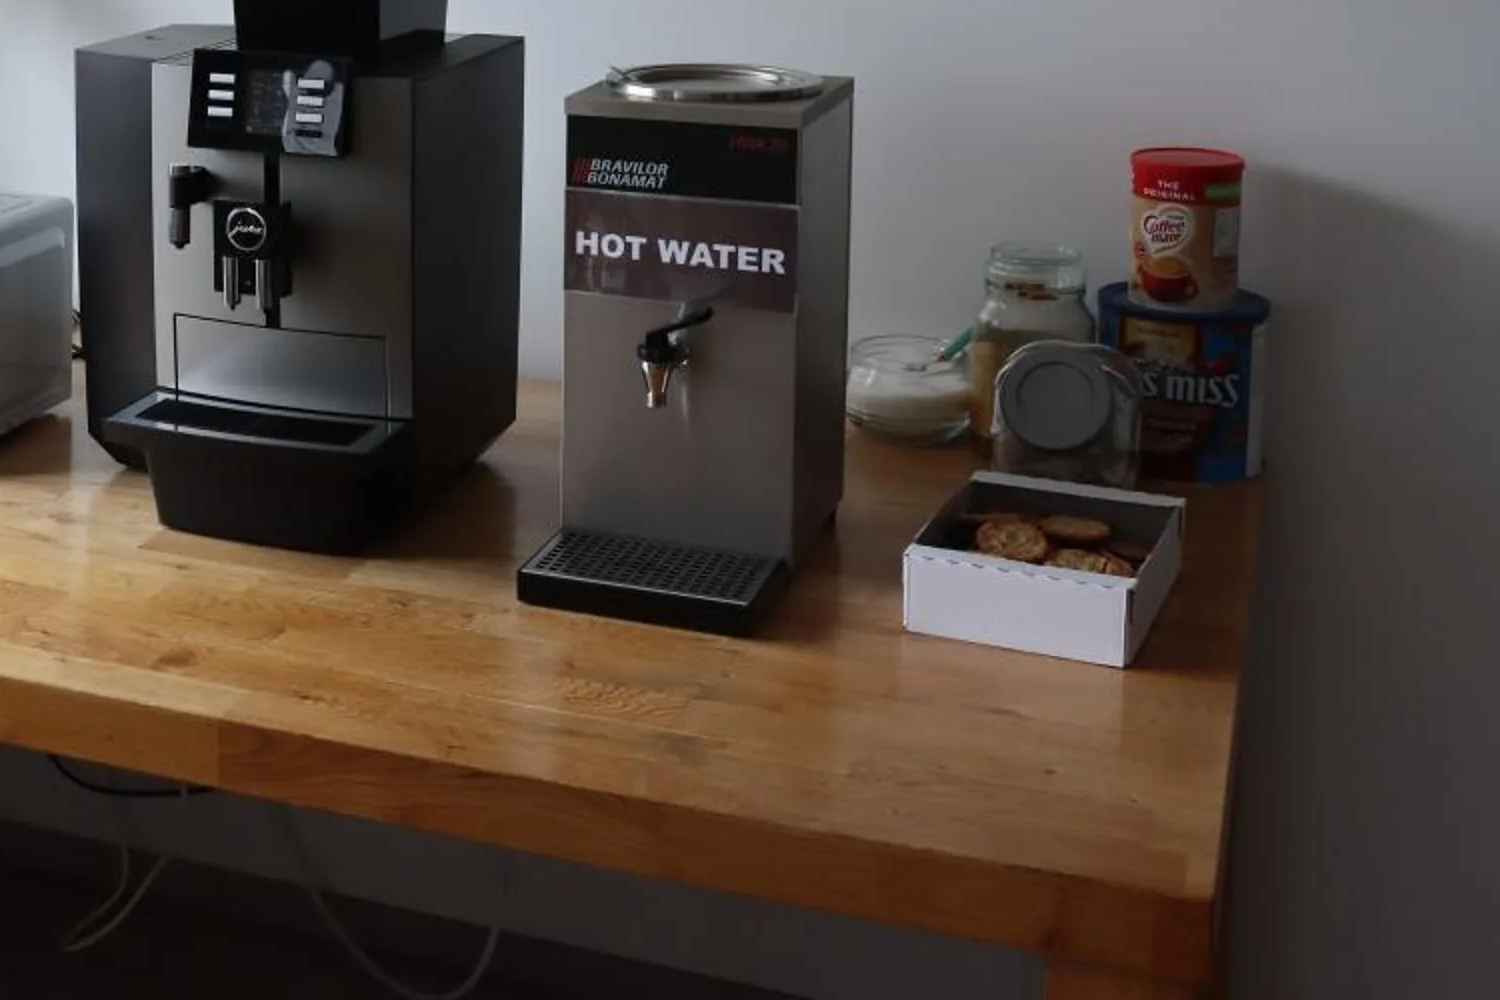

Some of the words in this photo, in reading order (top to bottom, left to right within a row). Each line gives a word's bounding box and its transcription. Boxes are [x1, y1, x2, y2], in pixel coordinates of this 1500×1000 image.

[590, 157, 669, 177] BRAVILOR
[587, 171, 667, 189] BONAMAT
[1157, 179, 1180, 190] THE
[1143, 187, 1196, 201] ORIGINAL
[575, 231, 647, 261] HOT
[657, 238, 786, 275] WATER
